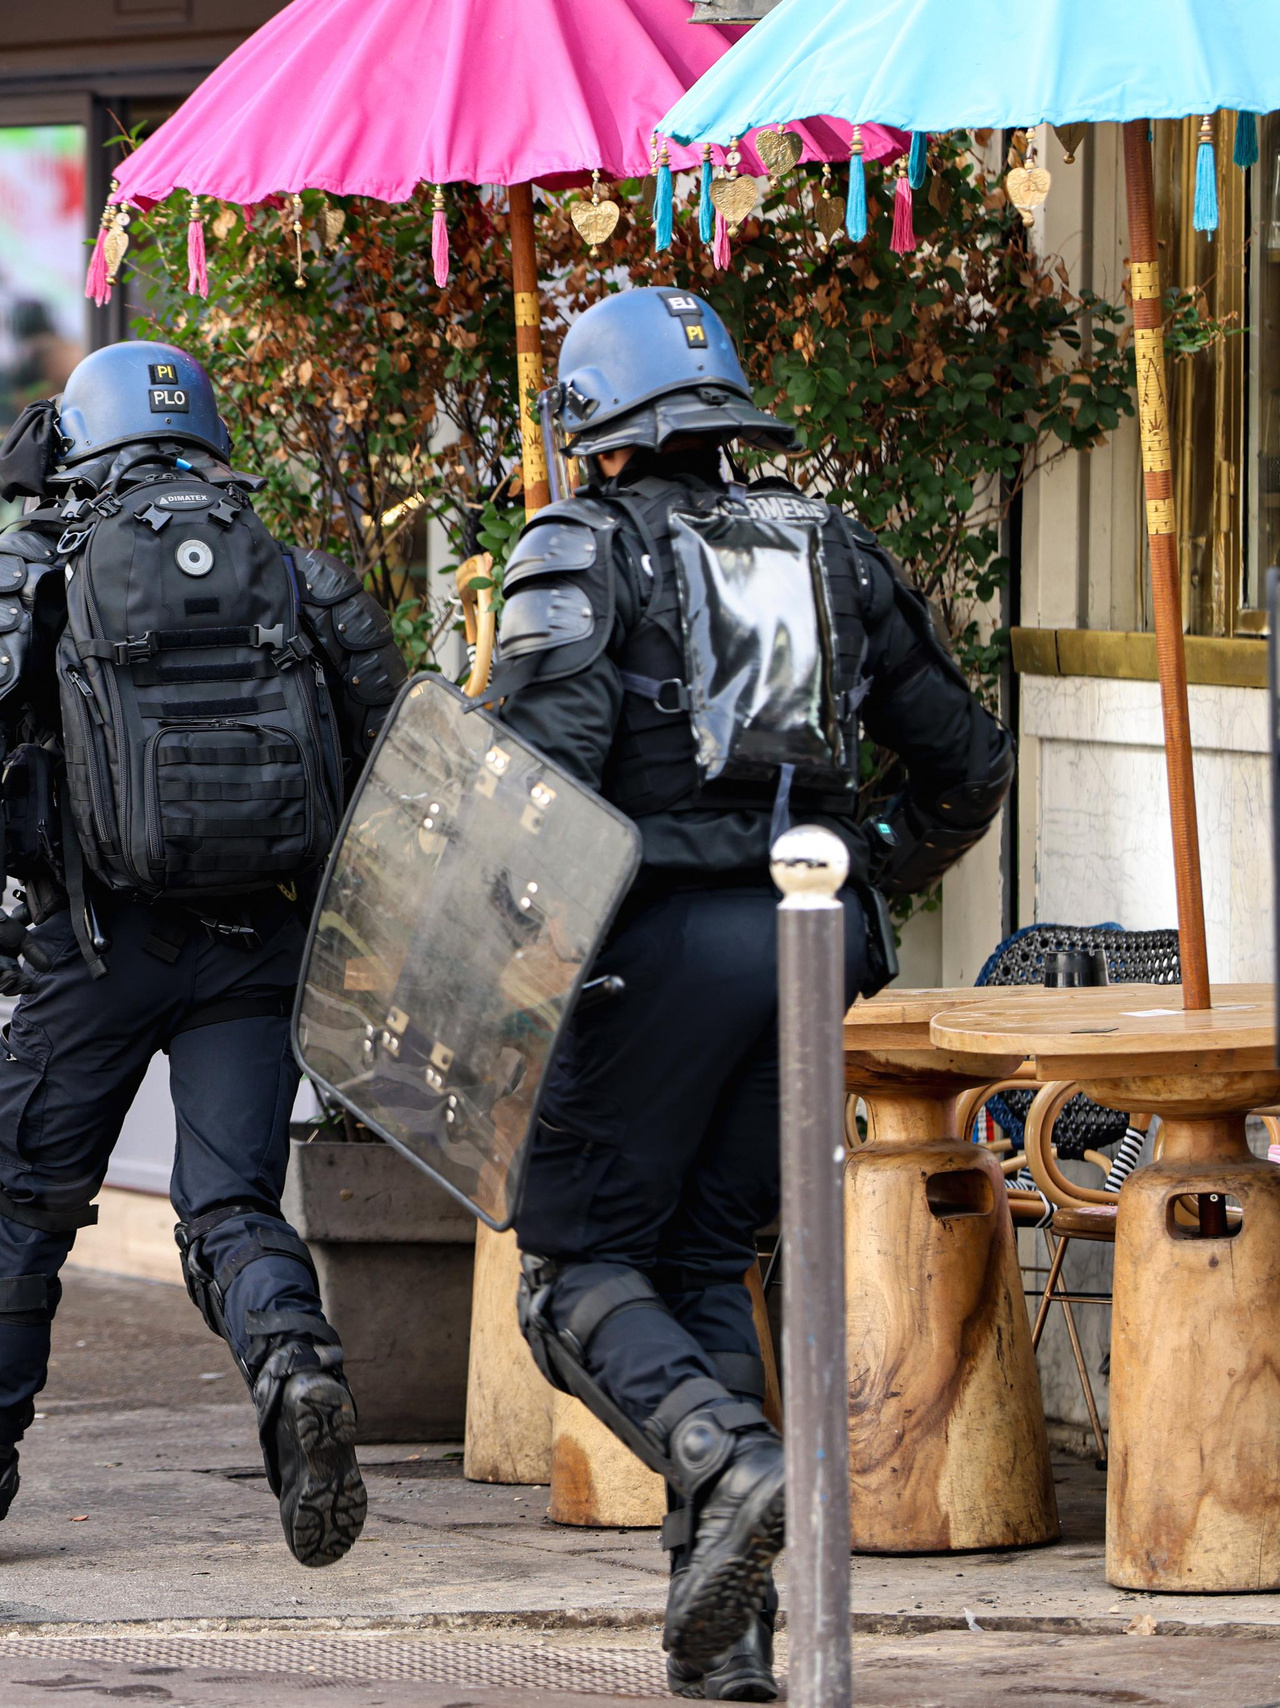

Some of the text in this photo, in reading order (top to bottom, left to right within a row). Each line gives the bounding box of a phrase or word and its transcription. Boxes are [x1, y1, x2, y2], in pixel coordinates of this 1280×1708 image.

[686, 325, 704, 341] PI
[157, 365, 174, 378] PI
[153, 390, 186, 405] PLO
[167, 494, 208, 502] DIMATEX
